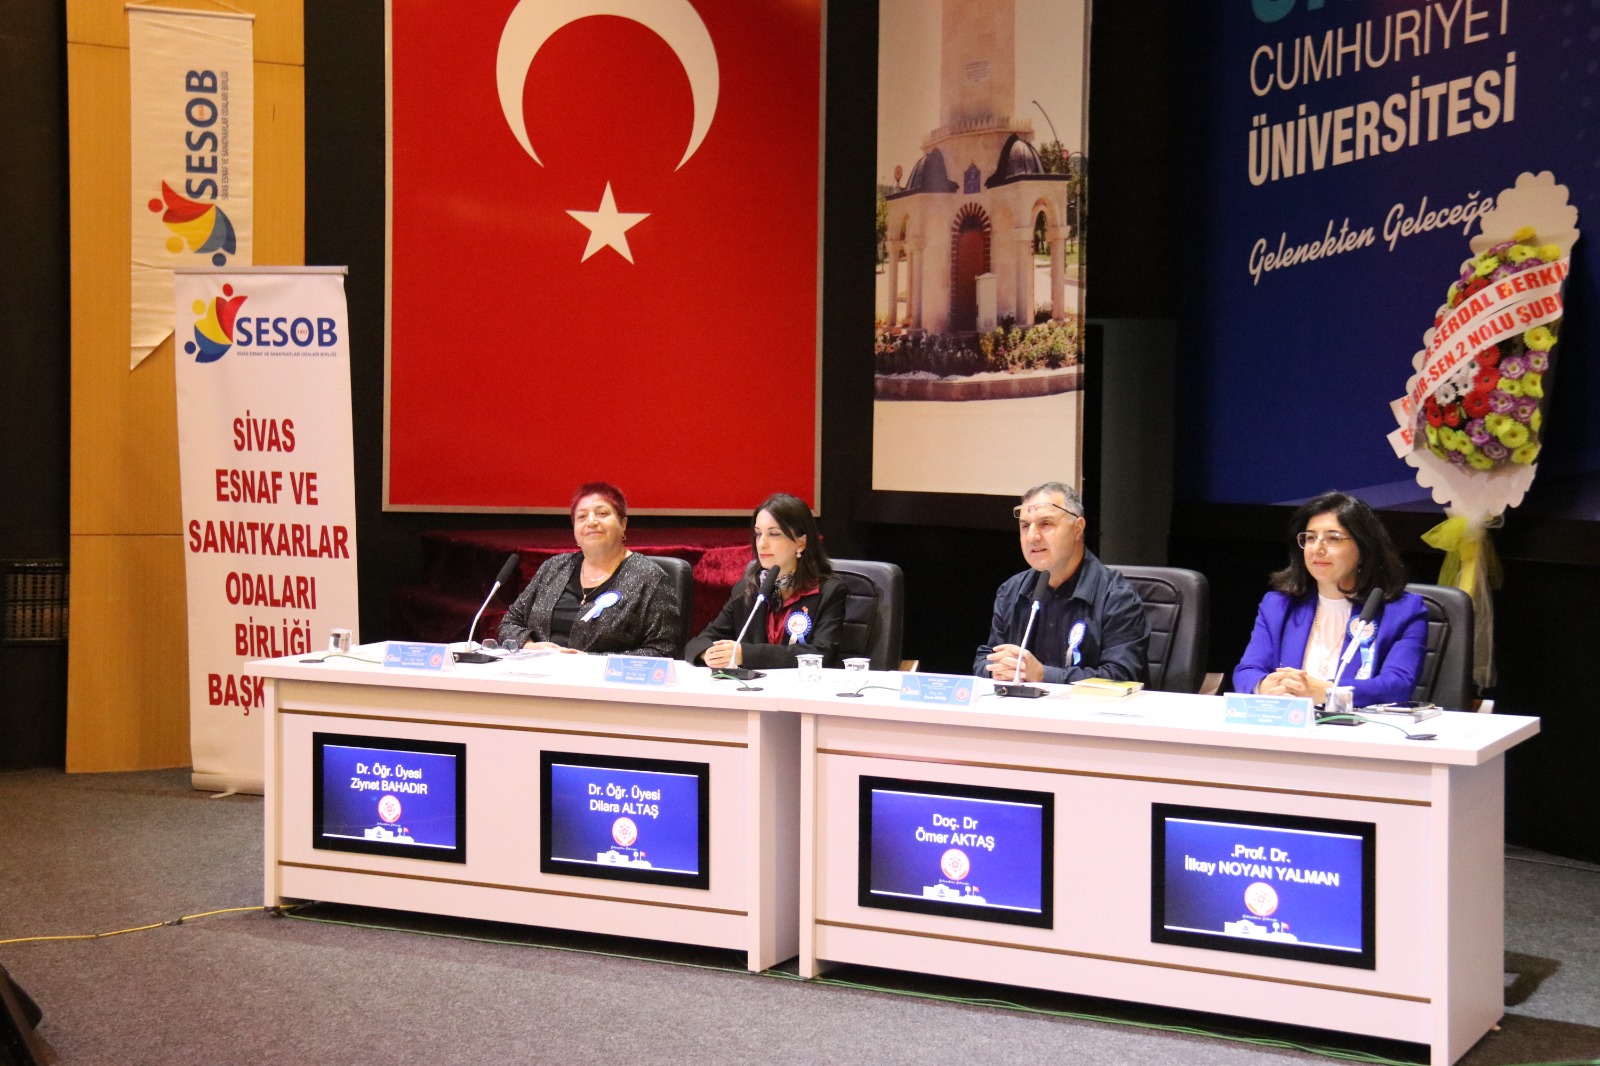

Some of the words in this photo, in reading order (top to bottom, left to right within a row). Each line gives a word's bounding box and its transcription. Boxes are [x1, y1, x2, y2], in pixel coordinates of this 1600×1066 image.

[185, 69, 218, 200] SESOB
[1248, 51, 1517, 187] ÜNİVERSİTESİ
[1249, 217, 1376, 286] Gelenekten
[1383, 190, 1495, 252] Geleceğe
[1433, 293, 1494, 350] SERDAL
[1495, 261, 1568, 300] BERKİ
[236, 317, 338, 347] SESOB
[1467, 312, 1515, 349] NOLU
[233, 409, 296, 453] SİVAS
[215, 468, 283, 504] ESNAF
[289, 471, 319, 506] VE
[188, 519, 350, 559] SANATKARLAR
[225, 571, 317, 610] ODALARI
[235, 616, 312, 659] BİRLİĞİ
[350, 777, 380, 792] Ziynet
[381, 780, 428, 795] BAHADIR
[356, 762, 371, 775] Dr.
[372, 762, 393, 779] Öğr.
[395, 764, 422, 780] Üyesi
[588, 783, 604, 796] Dr.
[606, 782, 629, 800] Öğr.
[631, 785, 661, 802] Üyesi
[589, 799, 620, 813] Dilara
[621, 802, 659, 819] ALTAŞ
[915, 826, 948, 844] Ömer
[950, 832, 995, 851] AKTAŞ
[932, 813, 960, 831] Doç.
[963, 816, 978, 830] Dr
[1184, 854, 1216, 876] İlkay
[1218, 861, 1273, 880] NOYAN
[1275, 866, 1340, 887] YALMAN
[1270, 847, 1291, 863] Dr.
